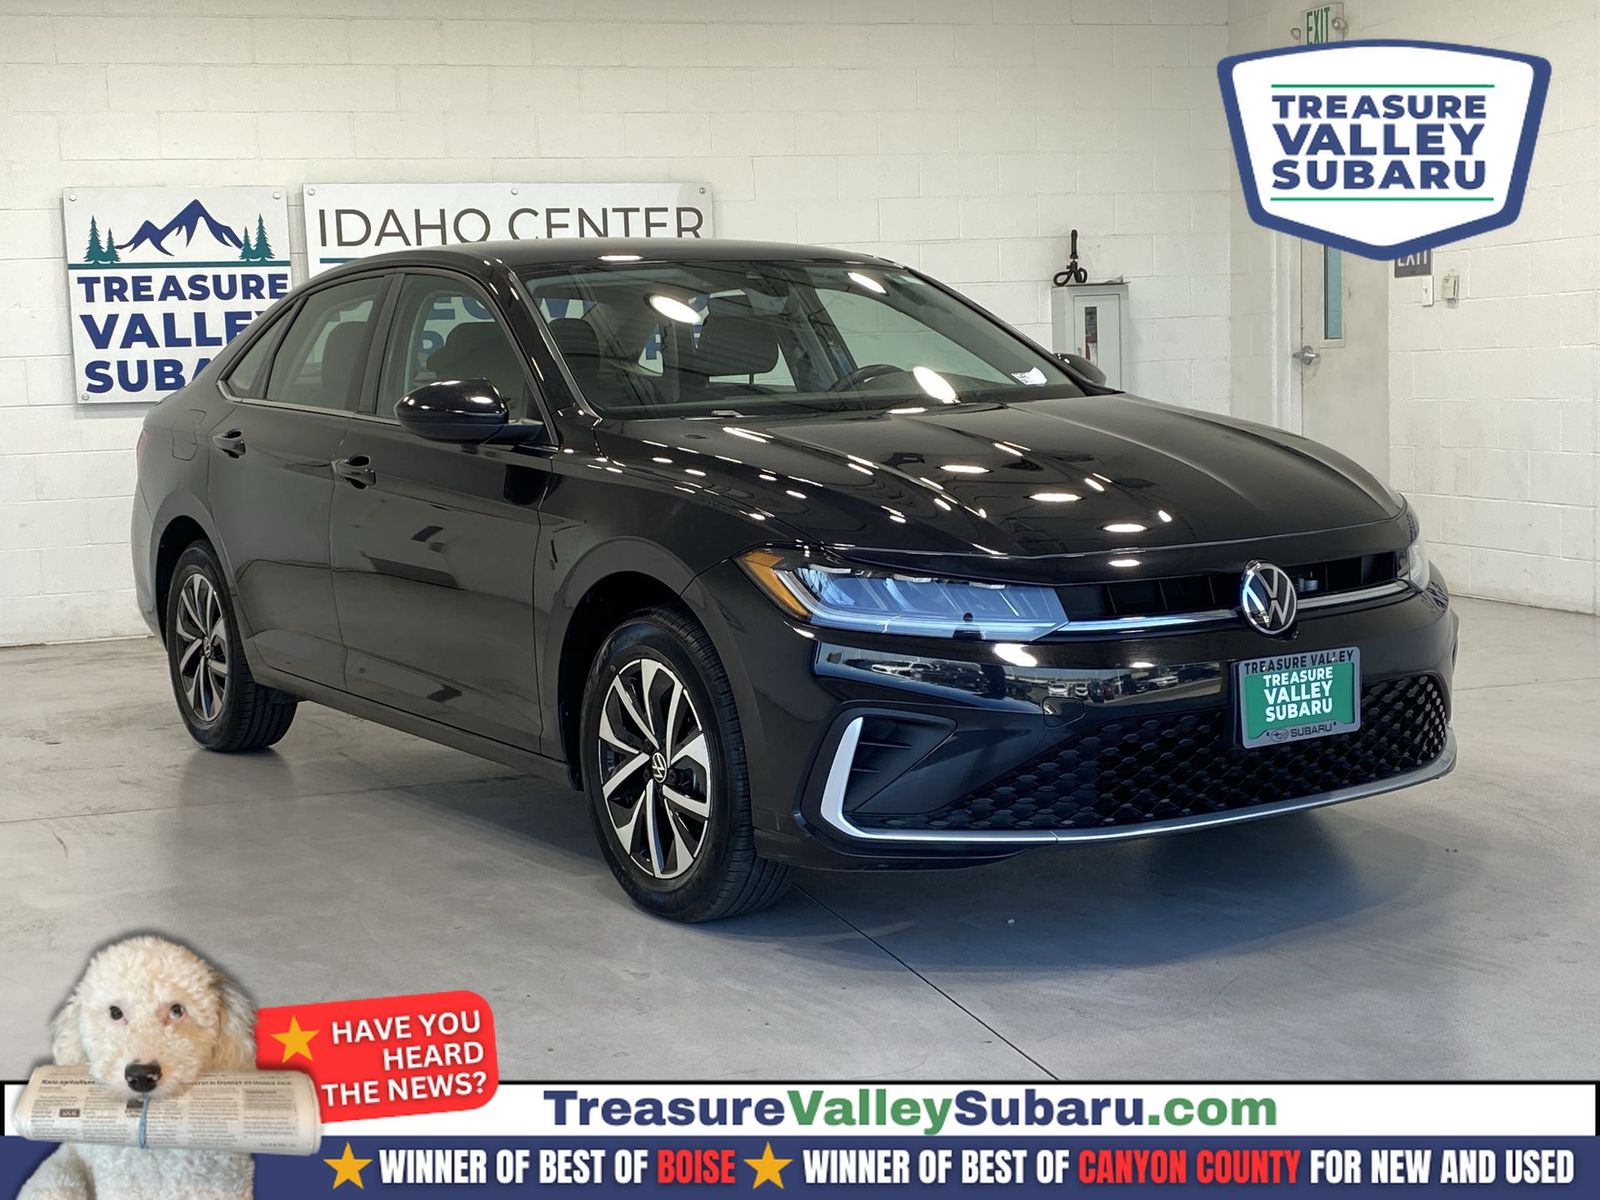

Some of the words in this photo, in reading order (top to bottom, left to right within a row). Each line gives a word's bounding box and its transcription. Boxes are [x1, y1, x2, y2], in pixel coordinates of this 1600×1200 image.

[1306, 6, 1330, 45] EXIT
[318, 207, 491, 247] IDAHO
[508, 206, 704, 240] CENTER
[77, 273, 289, 303] TREASURE
[79, 310, 265, 350] VALLE
[1244, 655, 1307, 675] TREASURE
[1263, 666, 1334, 687] TREASURE
[1264, 680, 1333, 705] VALLEY
[1265, 698, 1333, 723] SUBARU
[1290, 722, 1333, 738] SUBARU
